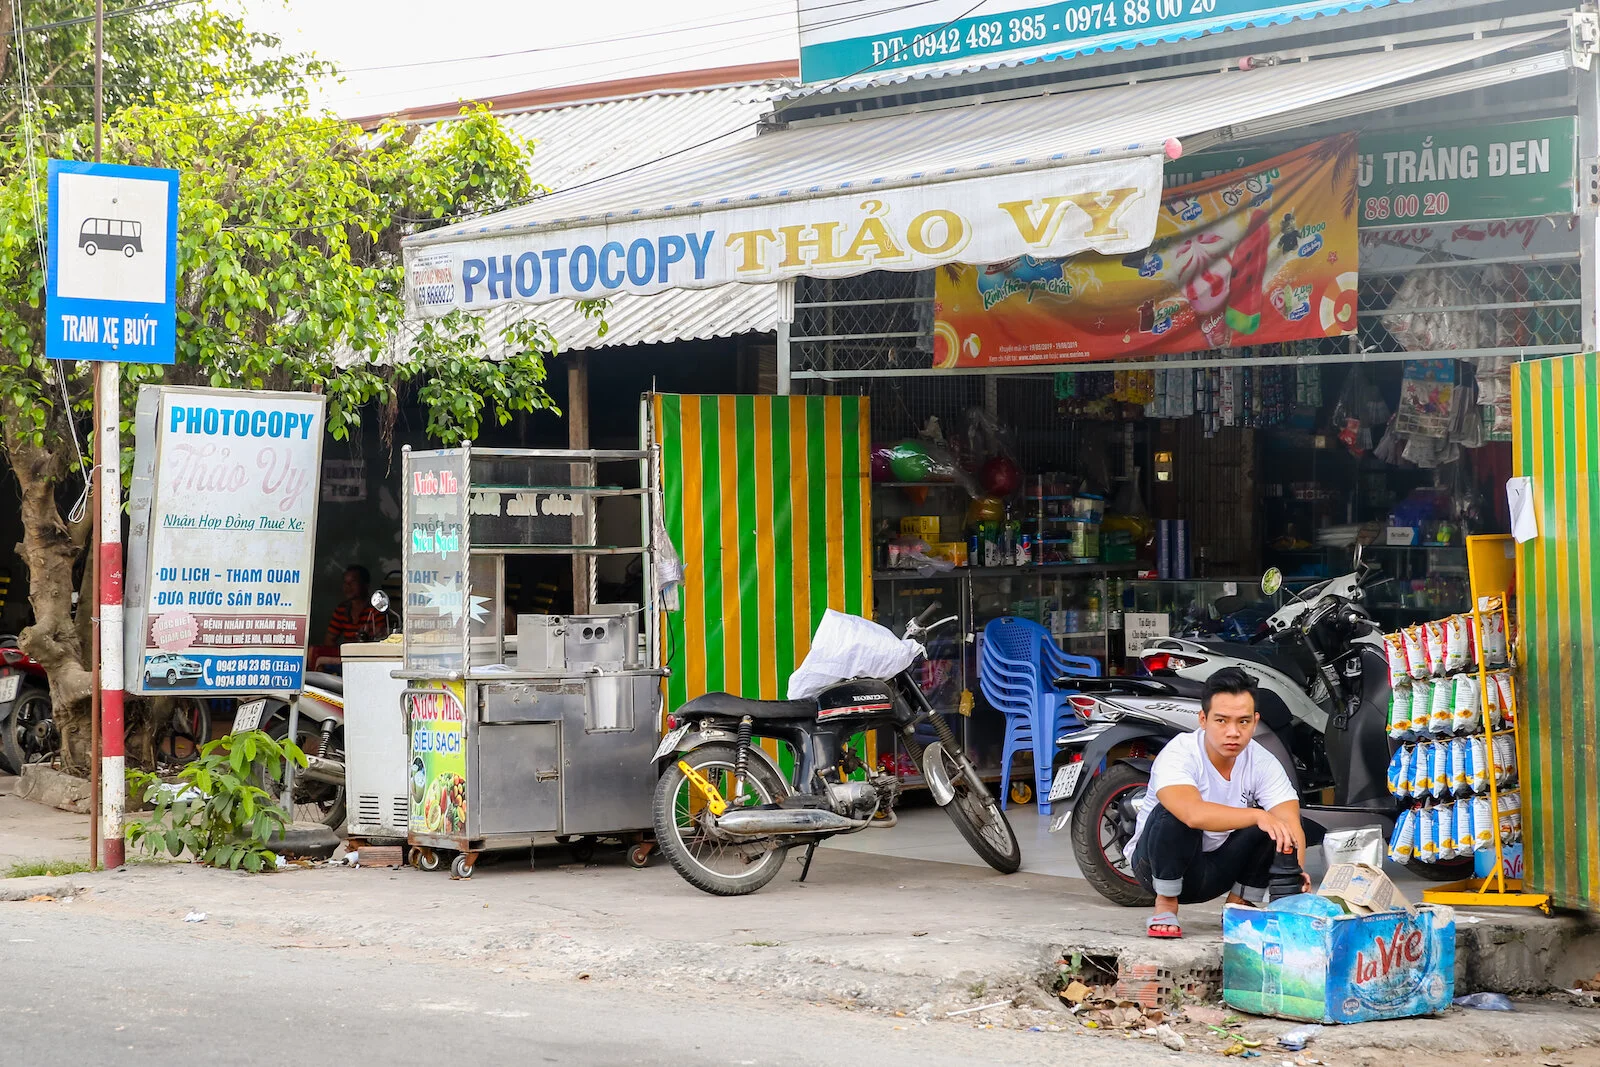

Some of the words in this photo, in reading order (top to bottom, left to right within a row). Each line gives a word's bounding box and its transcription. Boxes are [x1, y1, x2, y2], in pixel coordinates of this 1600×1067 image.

[872, 37, 908, 66] ĐT:
[913, 28, 960, 58] 0942
[966, 22, 1003, 49] 482
[1009, 14, 1046, 43] 385
[1065, 2, 1117, 33] 0974
[1124, 0, 1150, 25] 88
[1156, 0, 1182, 20] 00
[1383, 136, 1478, 185] TRẮNG
[1488, 138, 1549, 177] ĐEN
[1365, 196, 1390, 220] 88
[1394, 194, 1419, 218] 00
[1424, 192, 1449, 216] 20
[462, 230, 715, 303] PHOTOCOPY
[725, 199, 969, 272] THẢO
[999, 187, 1142, 248] VY
[1027, 278, 1047, 303] quà
[124, 313, 158, 346] BUÝT
[170, 406, 314, 439] PHOTOCOPY
[256, 447, 308, 512] Vy
[163, 514, 195, 530] Nhận
[199, 514, 222, 530] Hợp
[225, 513, 255, 531] Đồng
[259, 516, 285, 530] Thuê
[288, 517, 306, 530] Xe:
[160, 568, 177, 581] DU
[182, 568, 210, 584] LỊCH
[227, 569, 262, 583] THAM
[267, 570, 300, 584] QUAN
[158, 591, 184, 605] ĐƯA
[189, 588, 223, 606] RƯỚC
[227, 589, 252, 606] SÂN
[257, 592, 292, 607] BAY...
[203, 619, 223, 631] BỆNH
[224, 619, 245, 630] NHÂN
[254, 619, 275, 630] KHÁM
[216, 660, 236, 673] 0942
[238, 660, 249, 672] 84
[249, 660, 260, 672] 23
[260, 659, 271, 671] 85
[272, 659, 300, 672] (Hân)
[215, 675, 235, 687] 0974
[236, 675, 247, 687] 88
[248, 675, 259, 686] 00
[259, 674, 270, 686] 20
[271, 673, 292, 688] (Tú)
[852, 694, 888, 702] HONDA
[414, 727, 433, 751] SIÊU
[436, 732, 460, 755] SẠCH
